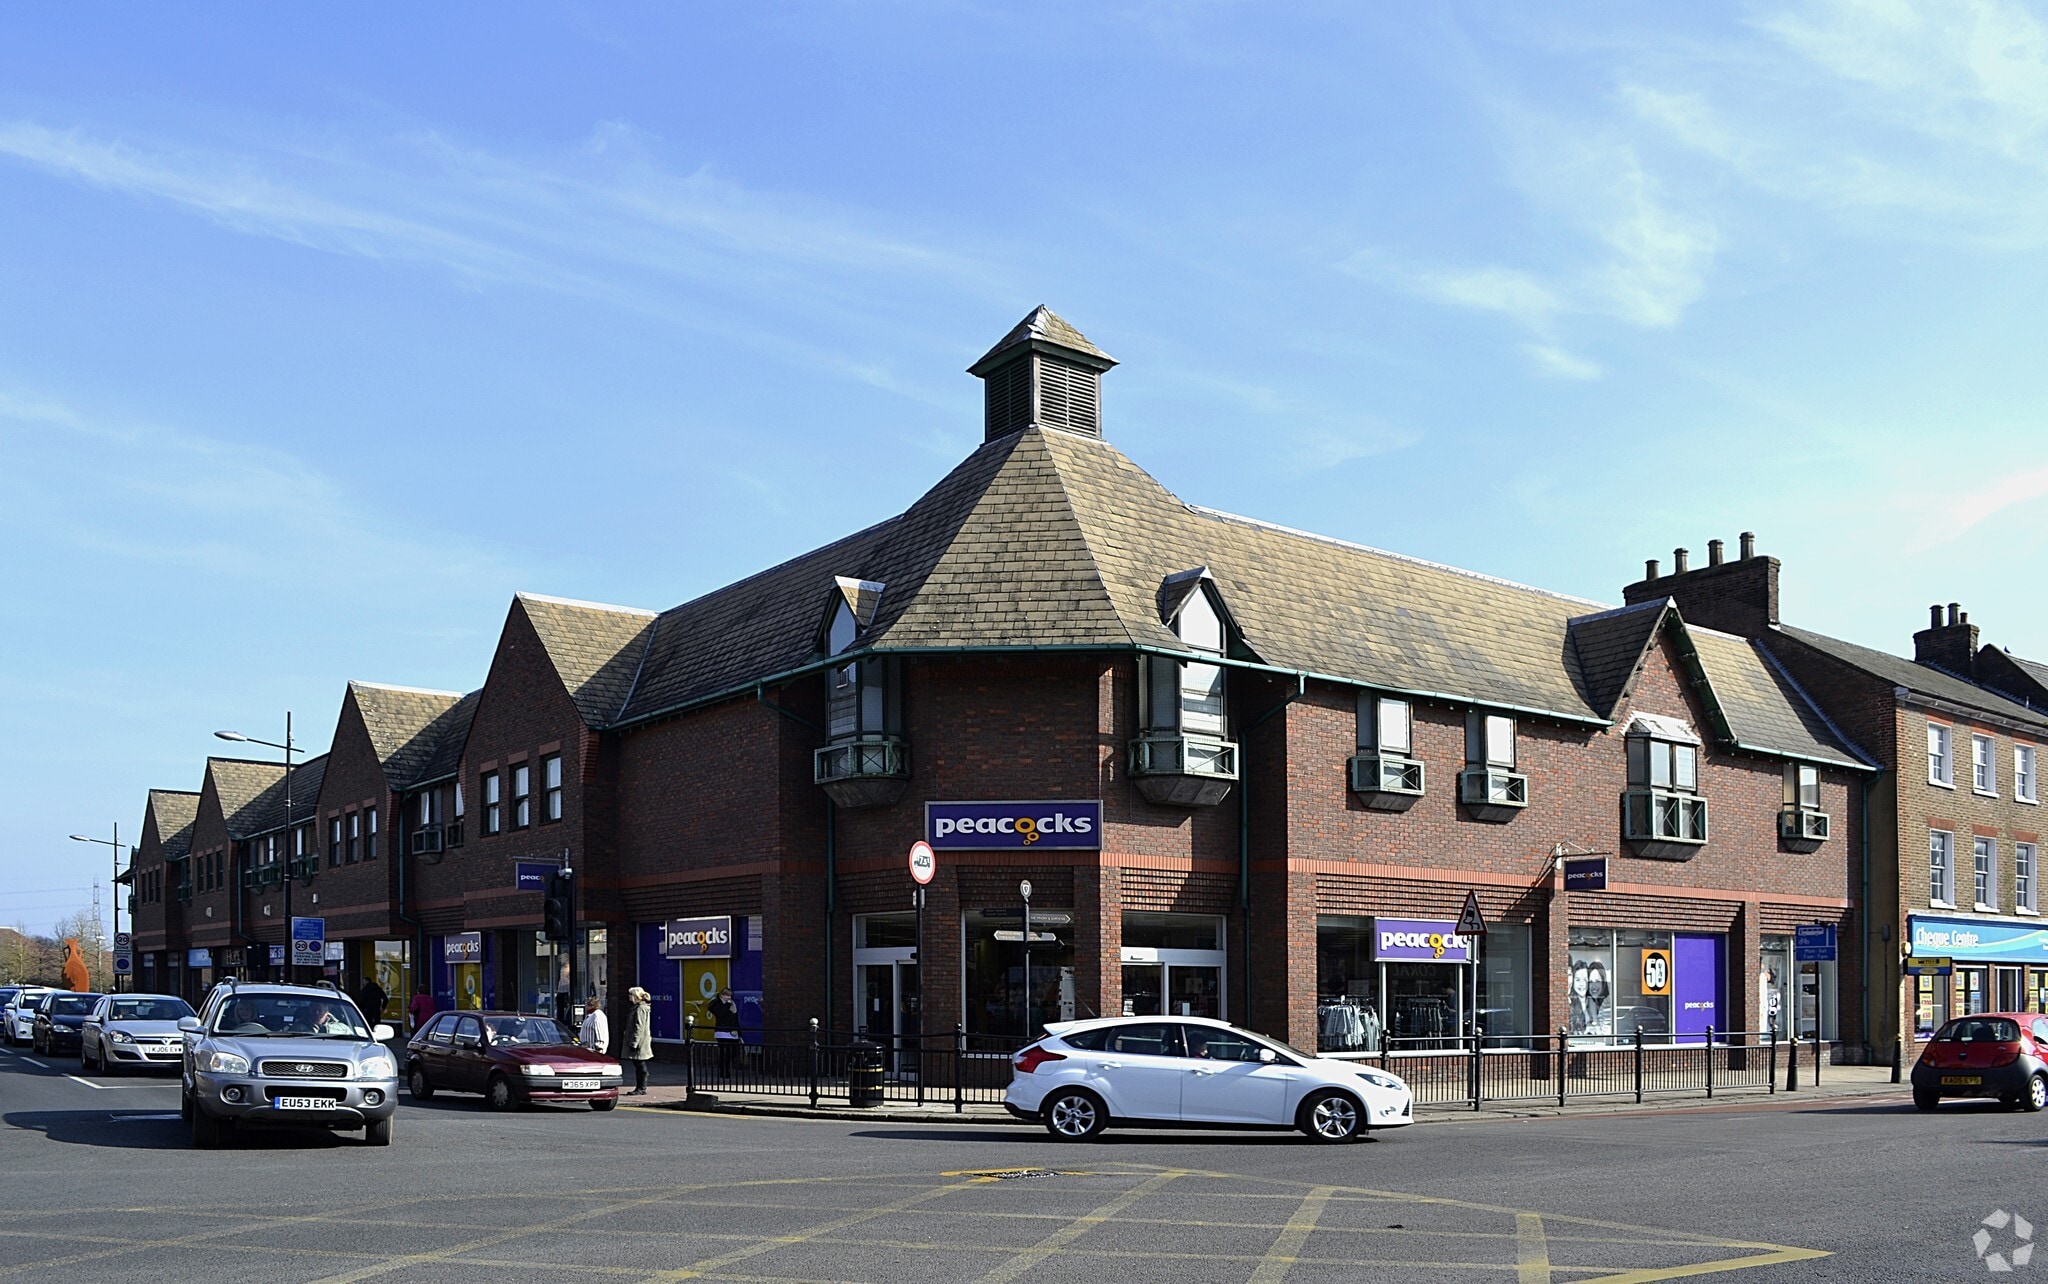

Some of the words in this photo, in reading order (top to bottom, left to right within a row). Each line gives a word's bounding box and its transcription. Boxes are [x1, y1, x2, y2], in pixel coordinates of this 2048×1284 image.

[935, 812, 1092, 843] peacocks
[1567, 871, 1604, 880] peacocks
[668, 927, 728, 951] peacocks
[1915, 926, 1950, 950] Cheque
[1951, 929, 1979, 948] Centre
[446, 940, 479, 957] peacocks
[1684, 1001, 1714, 1011] peacocks
[281, 1098, 311, 1108] EU53
[313, 1099, 335, 1109] EKK
